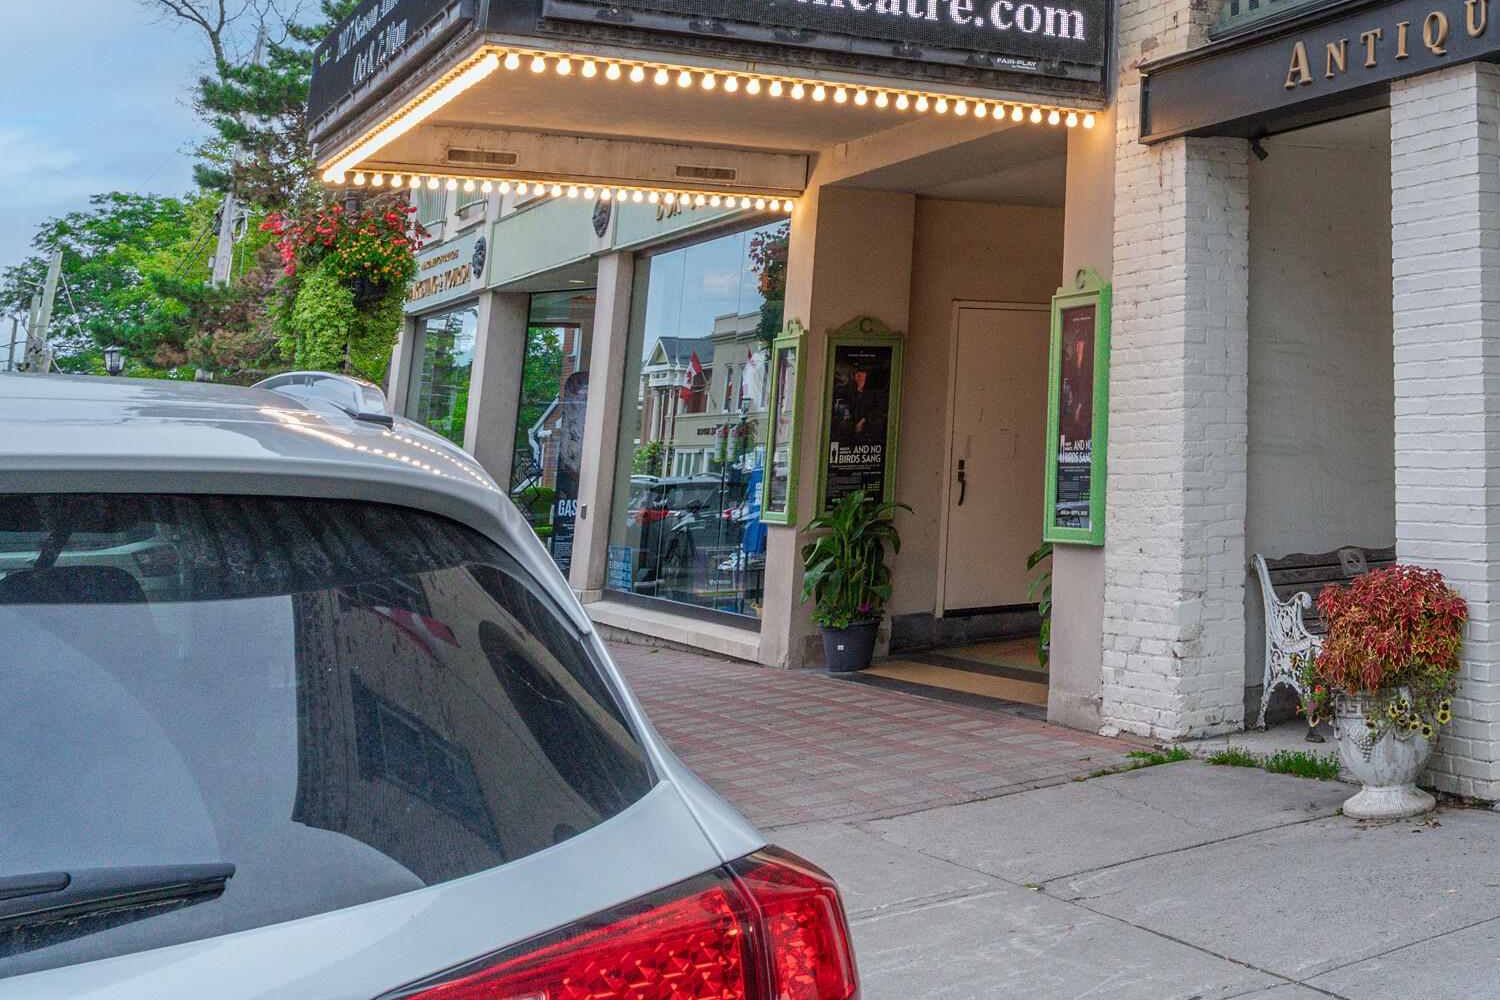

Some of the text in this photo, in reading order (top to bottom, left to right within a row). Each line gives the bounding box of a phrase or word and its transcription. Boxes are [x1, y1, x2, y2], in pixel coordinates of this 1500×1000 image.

[996, 57, 1037, 67] FAIR-PLAY
[853, 444, 882, 454] AND NO
[1073, 439, 1085, 451] AND
[838, 453, 881, 464] BIRDS SANG
[1064, 451, 1079, 463] BIRDS
